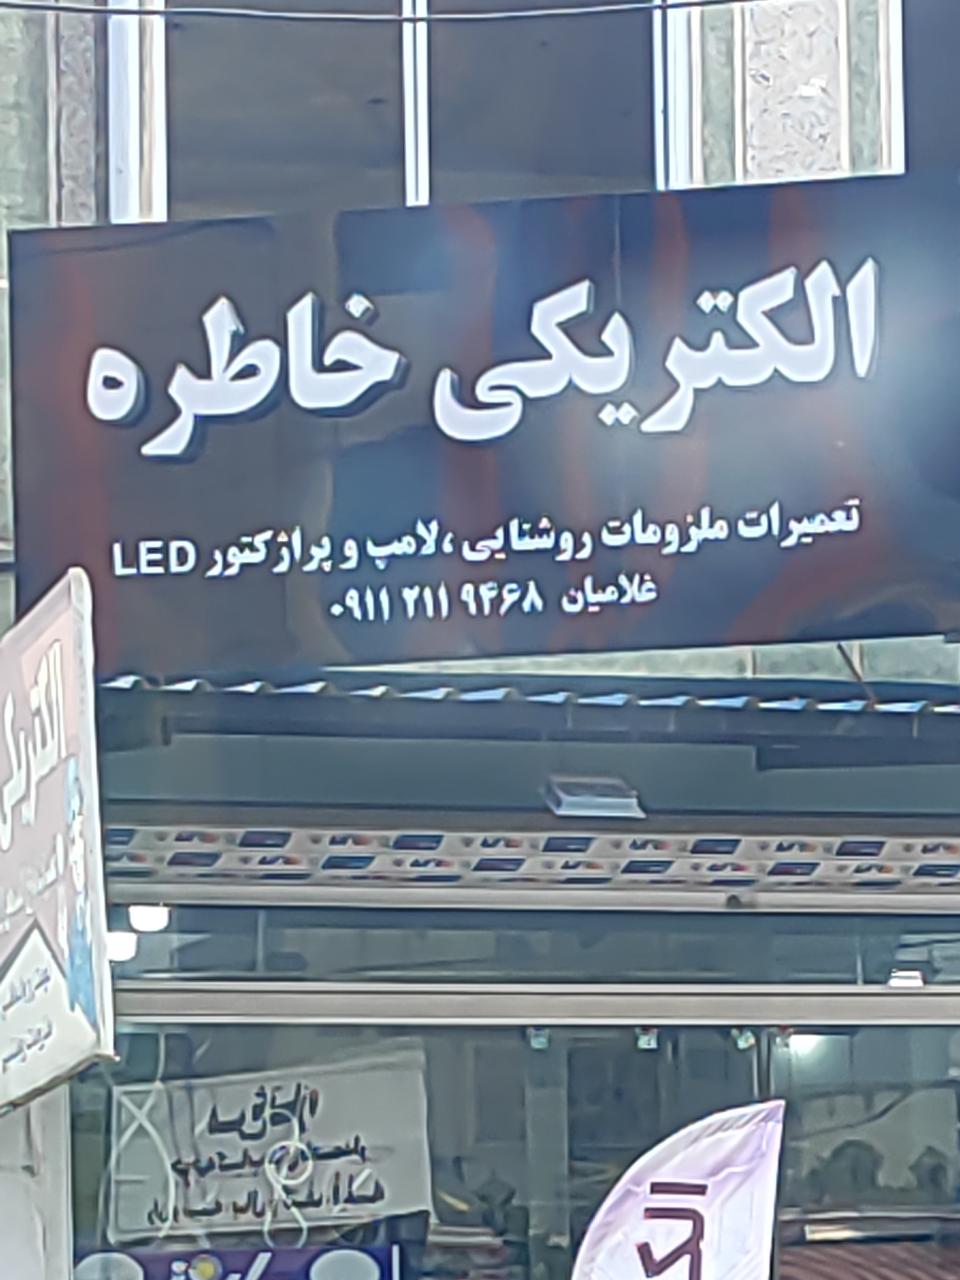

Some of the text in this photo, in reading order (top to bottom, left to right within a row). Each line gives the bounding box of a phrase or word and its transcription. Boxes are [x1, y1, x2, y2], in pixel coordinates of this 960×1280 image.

[84, 257, 880, 460] الکتریکی خاطره
[460, 513, 593, 563] روشنایی
[599, 504, 731, 556] ملزومات
[736, 497, 862, 550] تعمیرات
[111, 538, 197, 578] LED
[338, 537, 360, 571] و
[329, 571, 659, 624] غلامیان ۰۹۱۱ ۲۱۱ ۹۴۶۸
